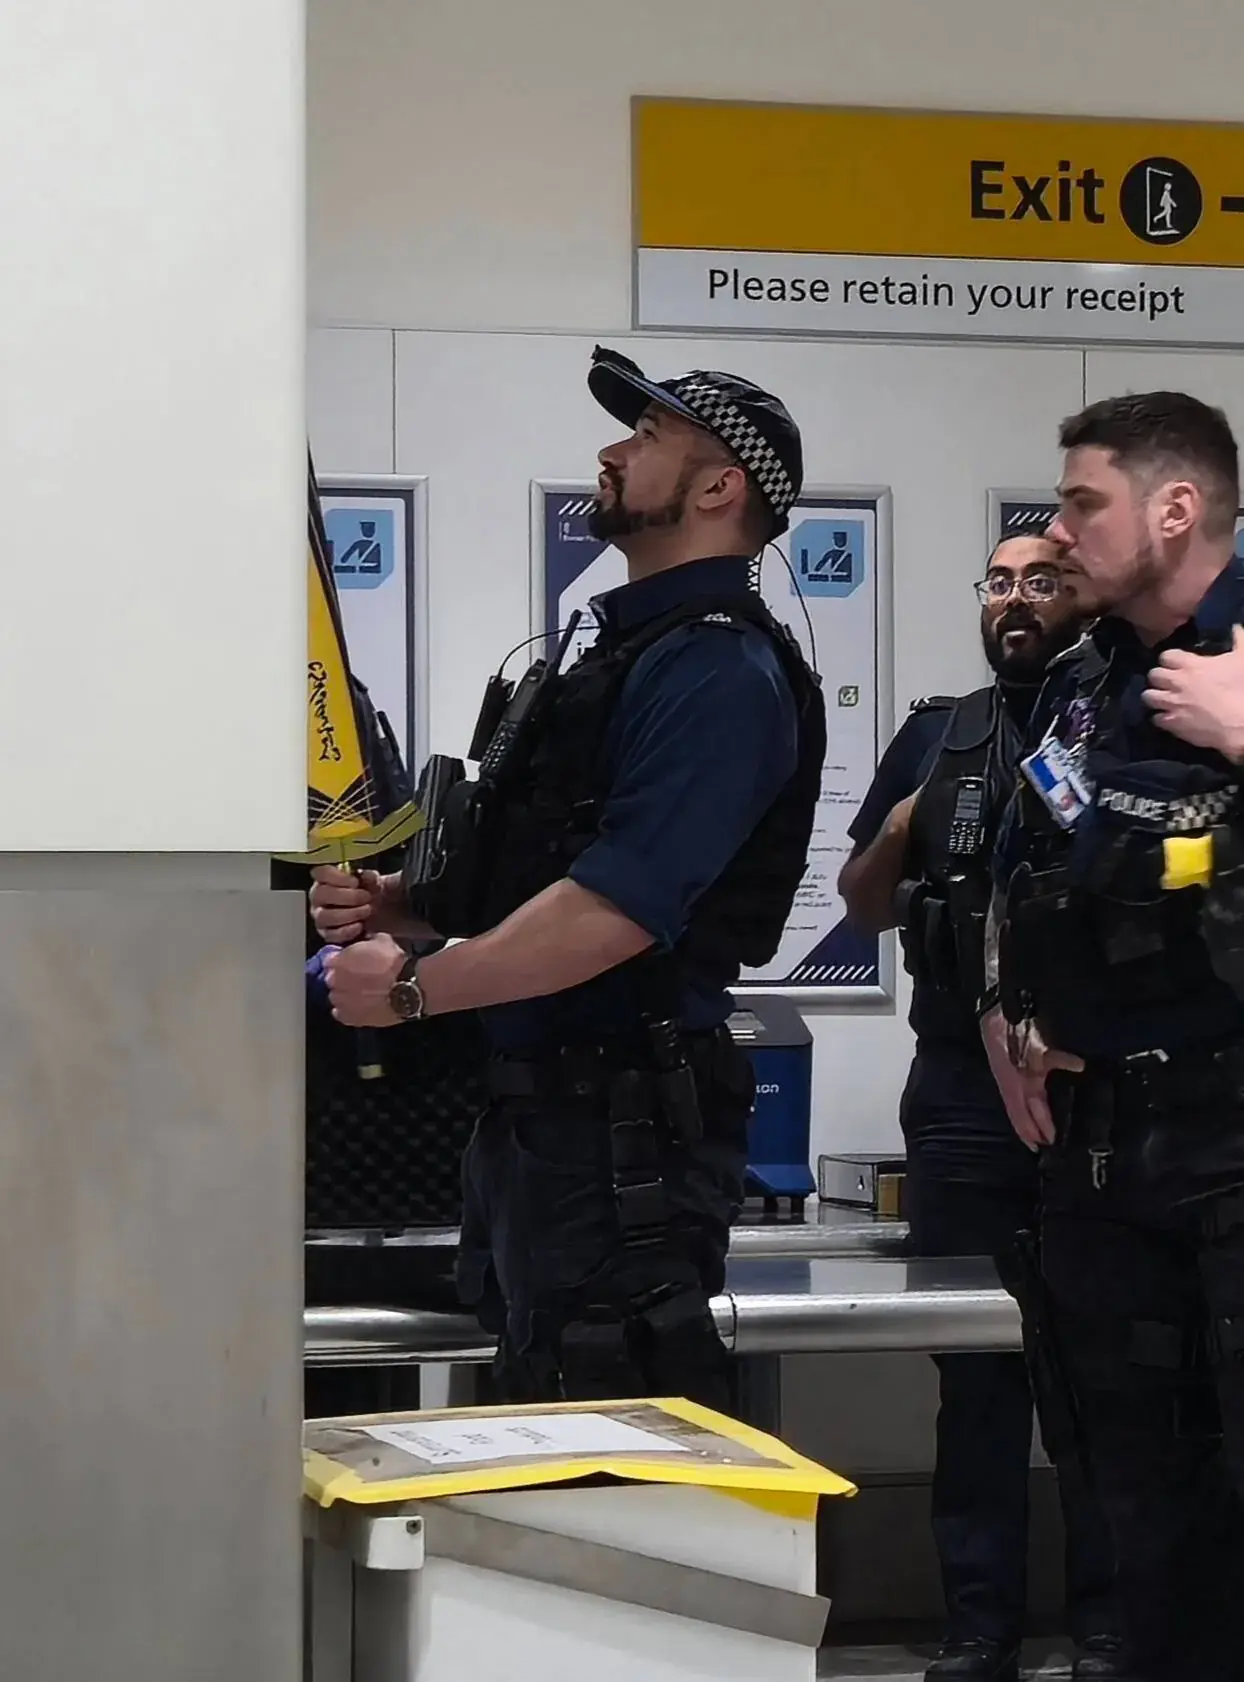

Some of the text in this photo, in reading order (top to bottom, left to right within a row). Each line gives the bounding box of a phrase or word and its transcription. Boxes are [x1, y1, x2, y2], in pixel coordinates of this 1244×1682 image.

[970, 159, 1106, 223] Exit
[708, 267, 1186, 322] Please retain your receipt
[1097, 788, 1168, 822] POLICE
